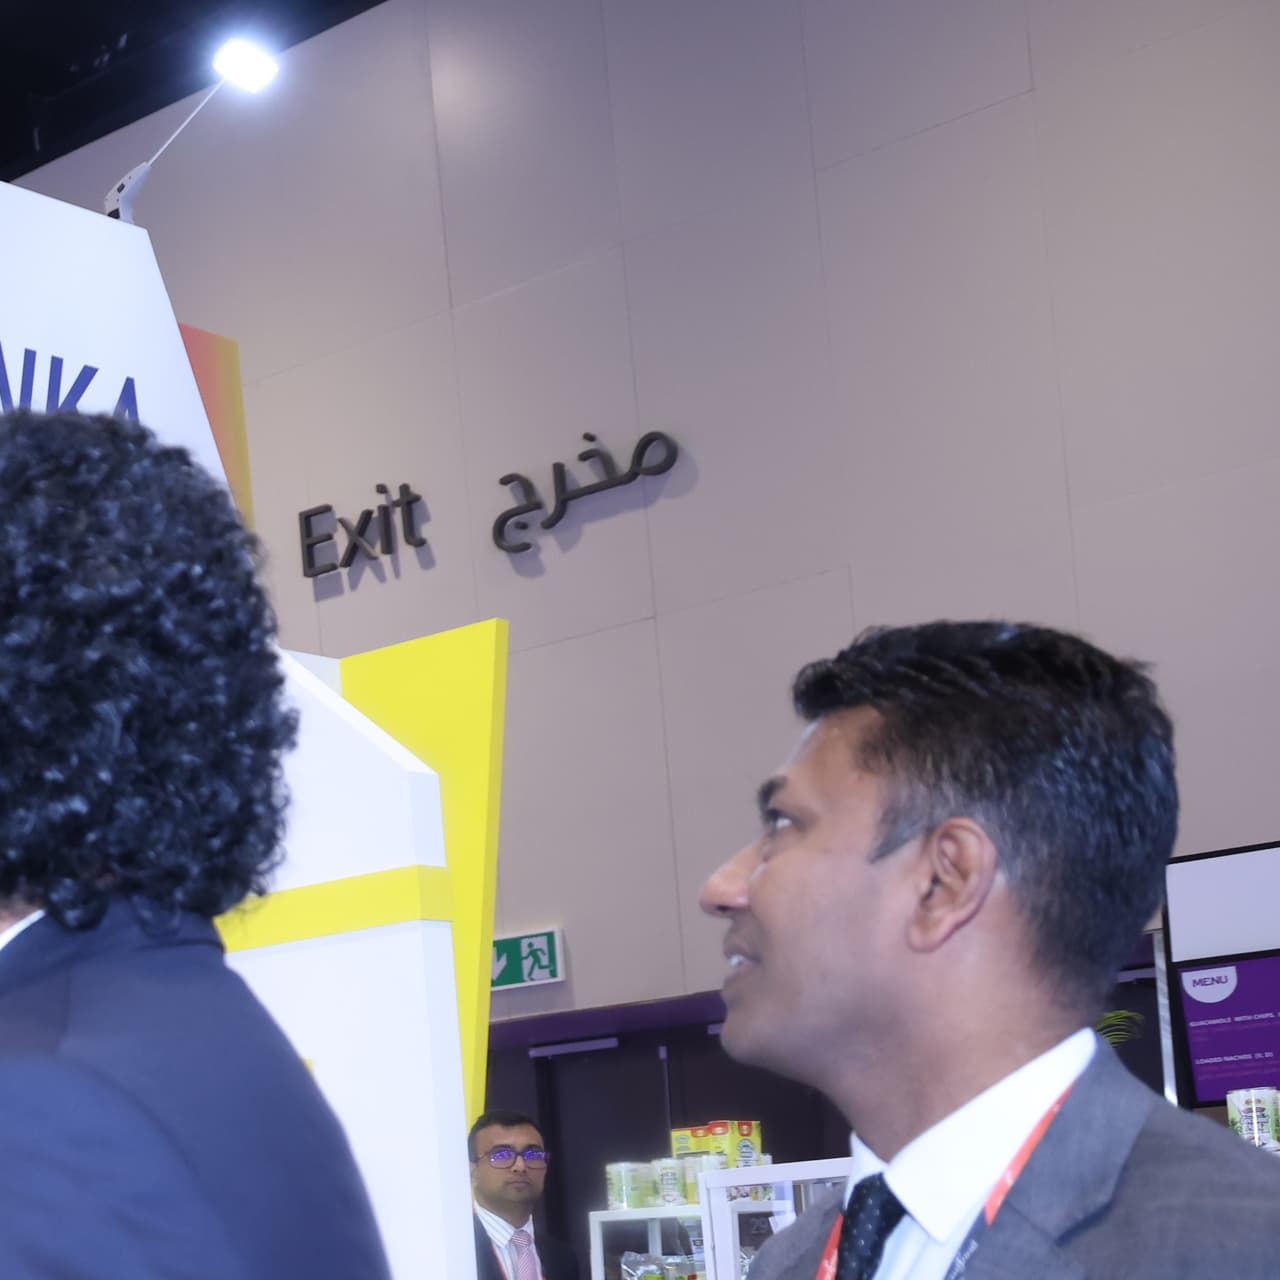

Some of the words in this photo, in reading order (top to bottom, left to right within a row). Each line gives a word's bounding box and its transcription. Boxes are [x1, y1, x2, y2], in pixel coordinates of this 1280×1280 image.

[299, 484, 426, 577] Exit
[493, 432, 678, 553] مخرج
[1192, 976, 1228, 987] MENU
